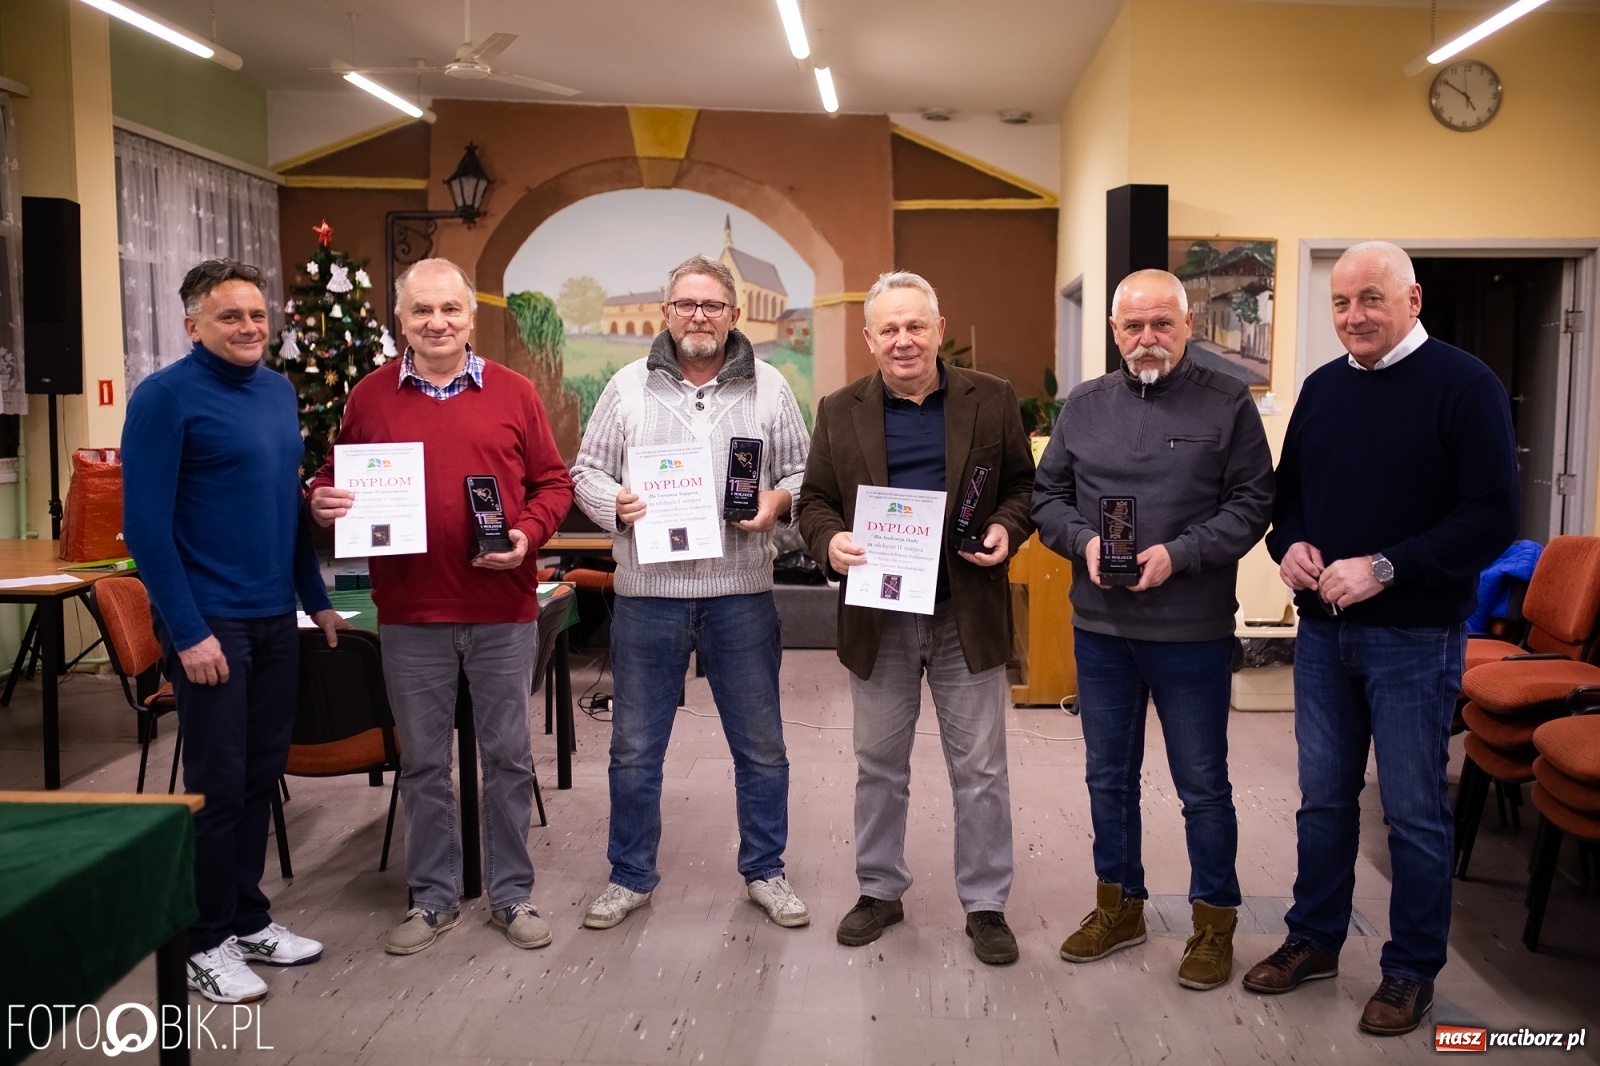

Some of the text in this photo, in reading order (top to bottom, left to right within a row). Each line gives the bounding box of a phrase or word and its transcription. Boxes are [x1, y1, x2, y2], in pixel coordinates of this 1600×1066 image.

[349, 477, 412, 487] DYPLOM
[643, 477, 703, 491] DYPLOM
[729, 480, 739, 491] 11
[476, 514, 487, 524] 11
[867, 521, 930, 536] DYPLOM
[1103, 542, 1114, 554] 11
